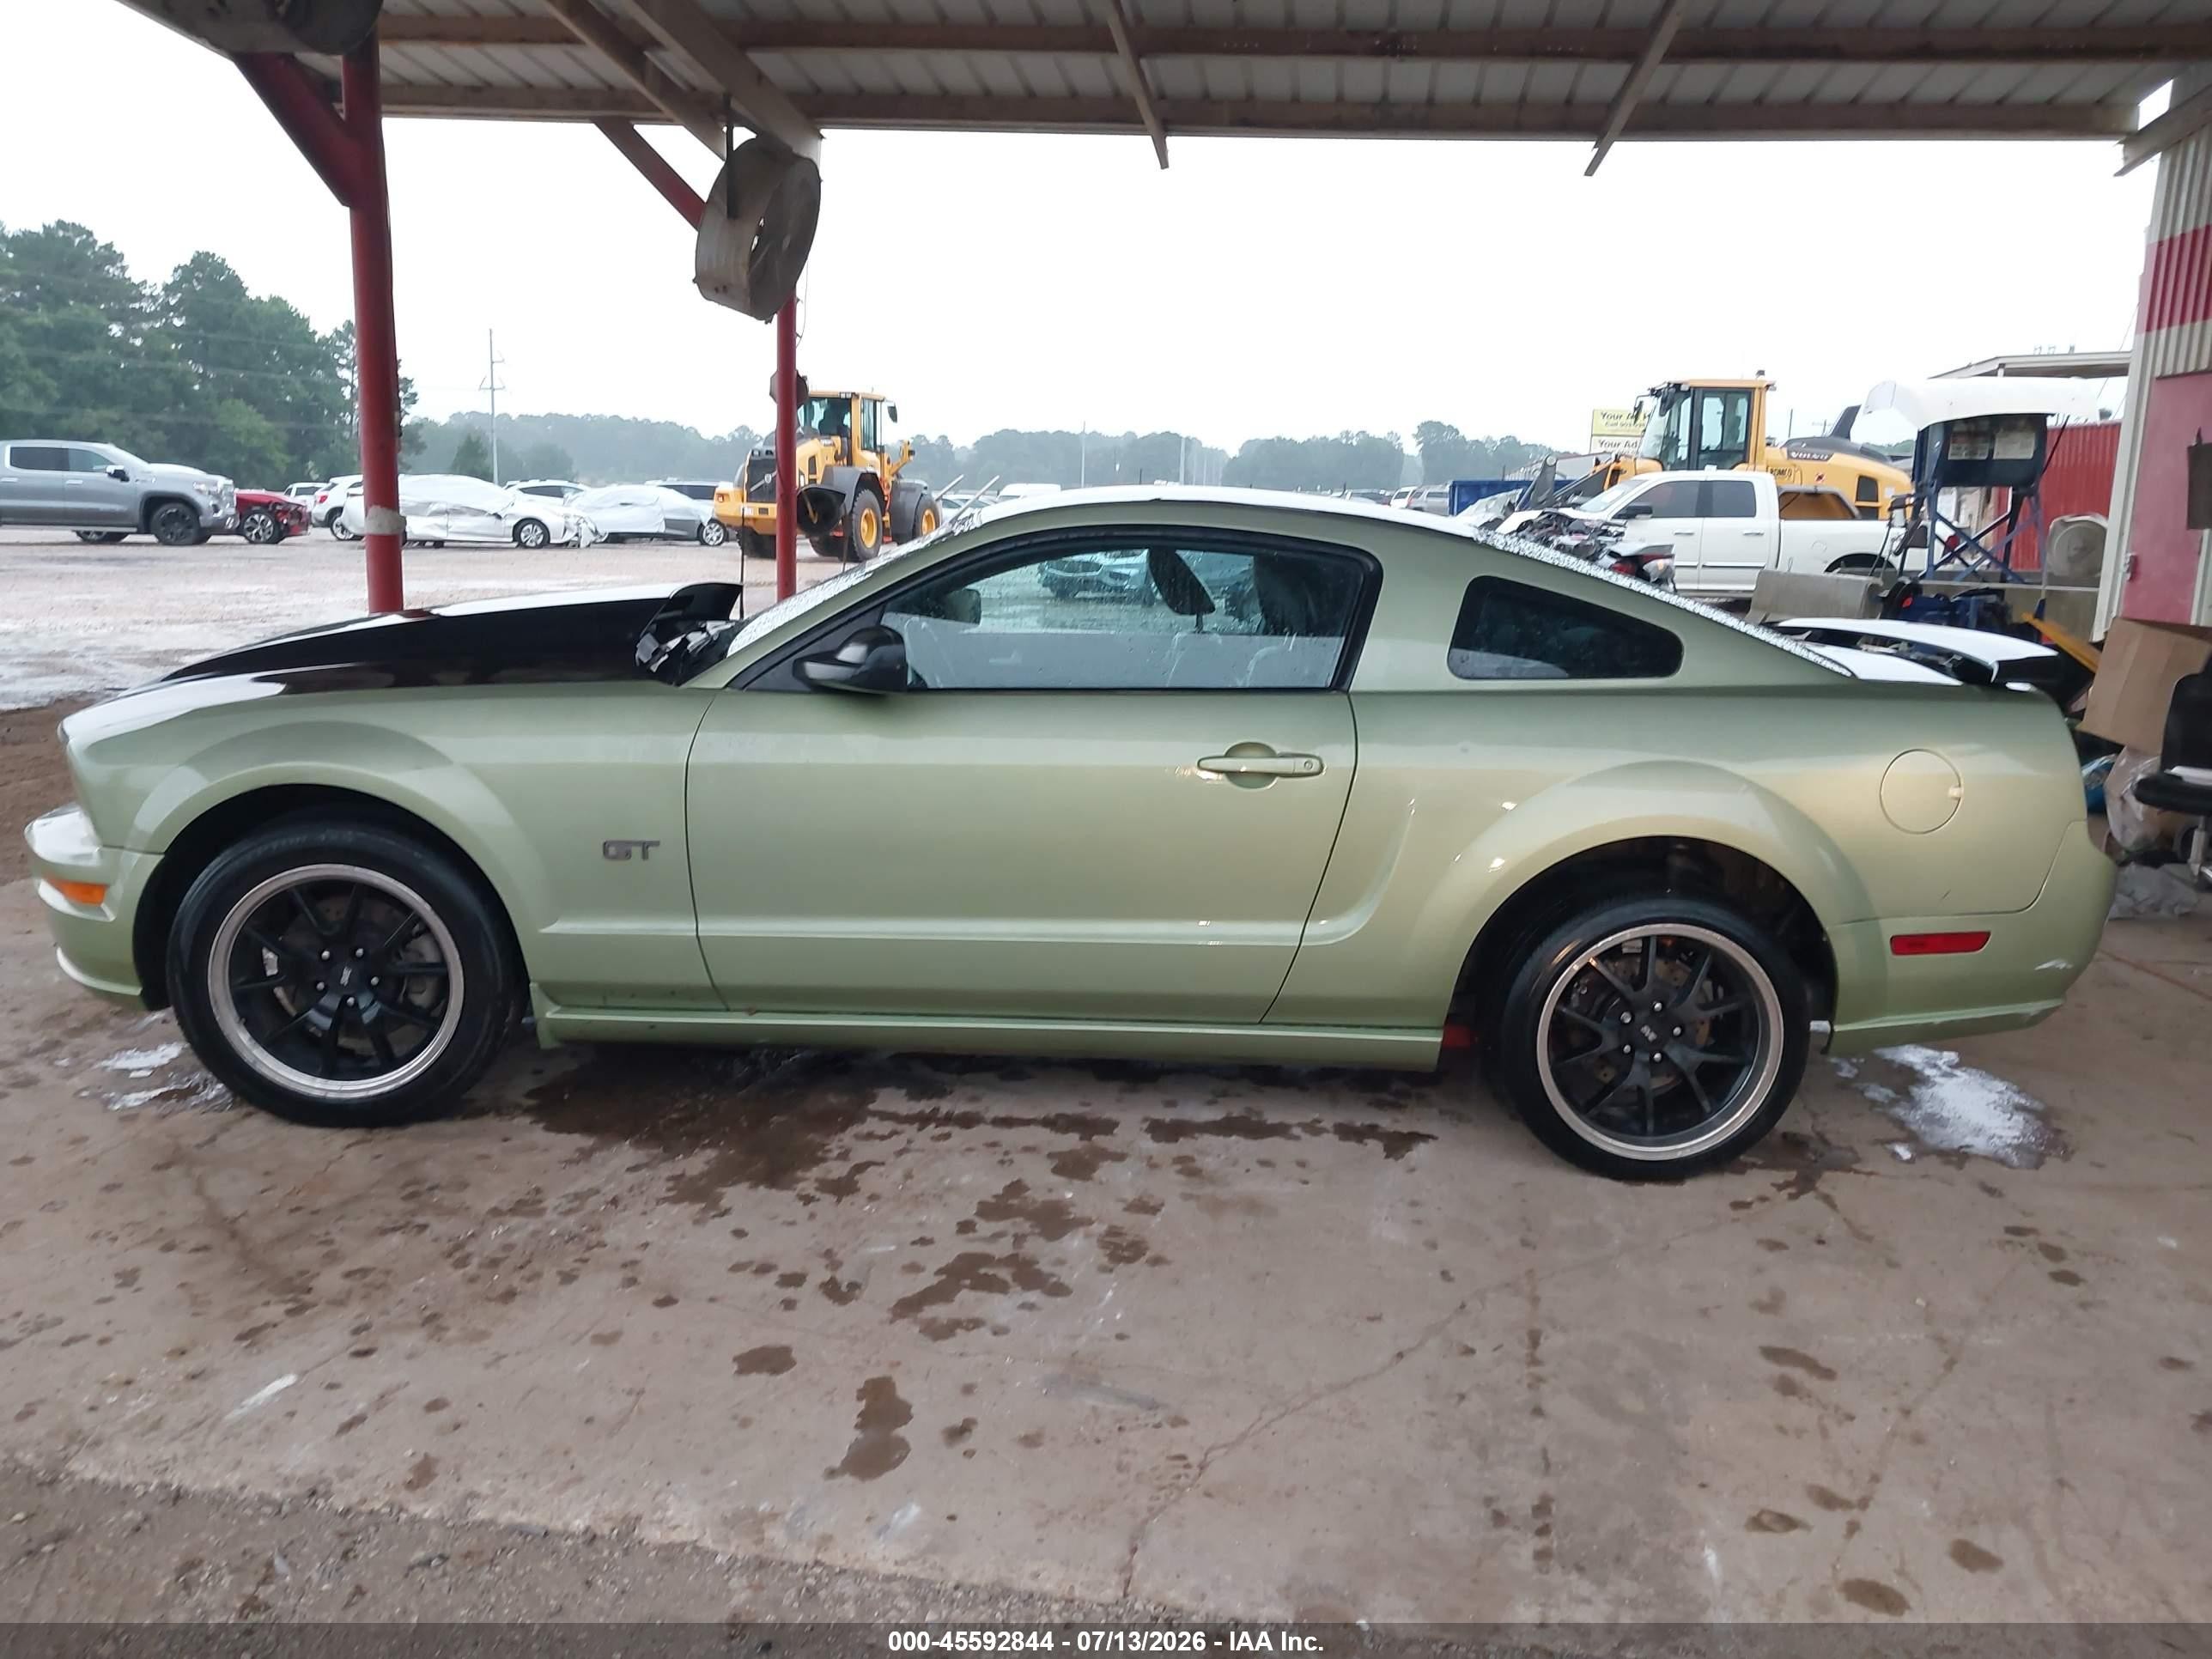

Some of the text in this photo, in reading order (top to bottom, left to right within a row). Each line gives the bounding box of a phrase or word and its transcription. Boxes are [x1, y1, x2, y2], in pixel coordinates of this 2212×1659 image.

[1601, 411, 1622, 420] Your
[1599, 439, 1620, 447] Your
[1791, 451, 1828, 460] VOLVO
[603, 840, 660, 860] GT
